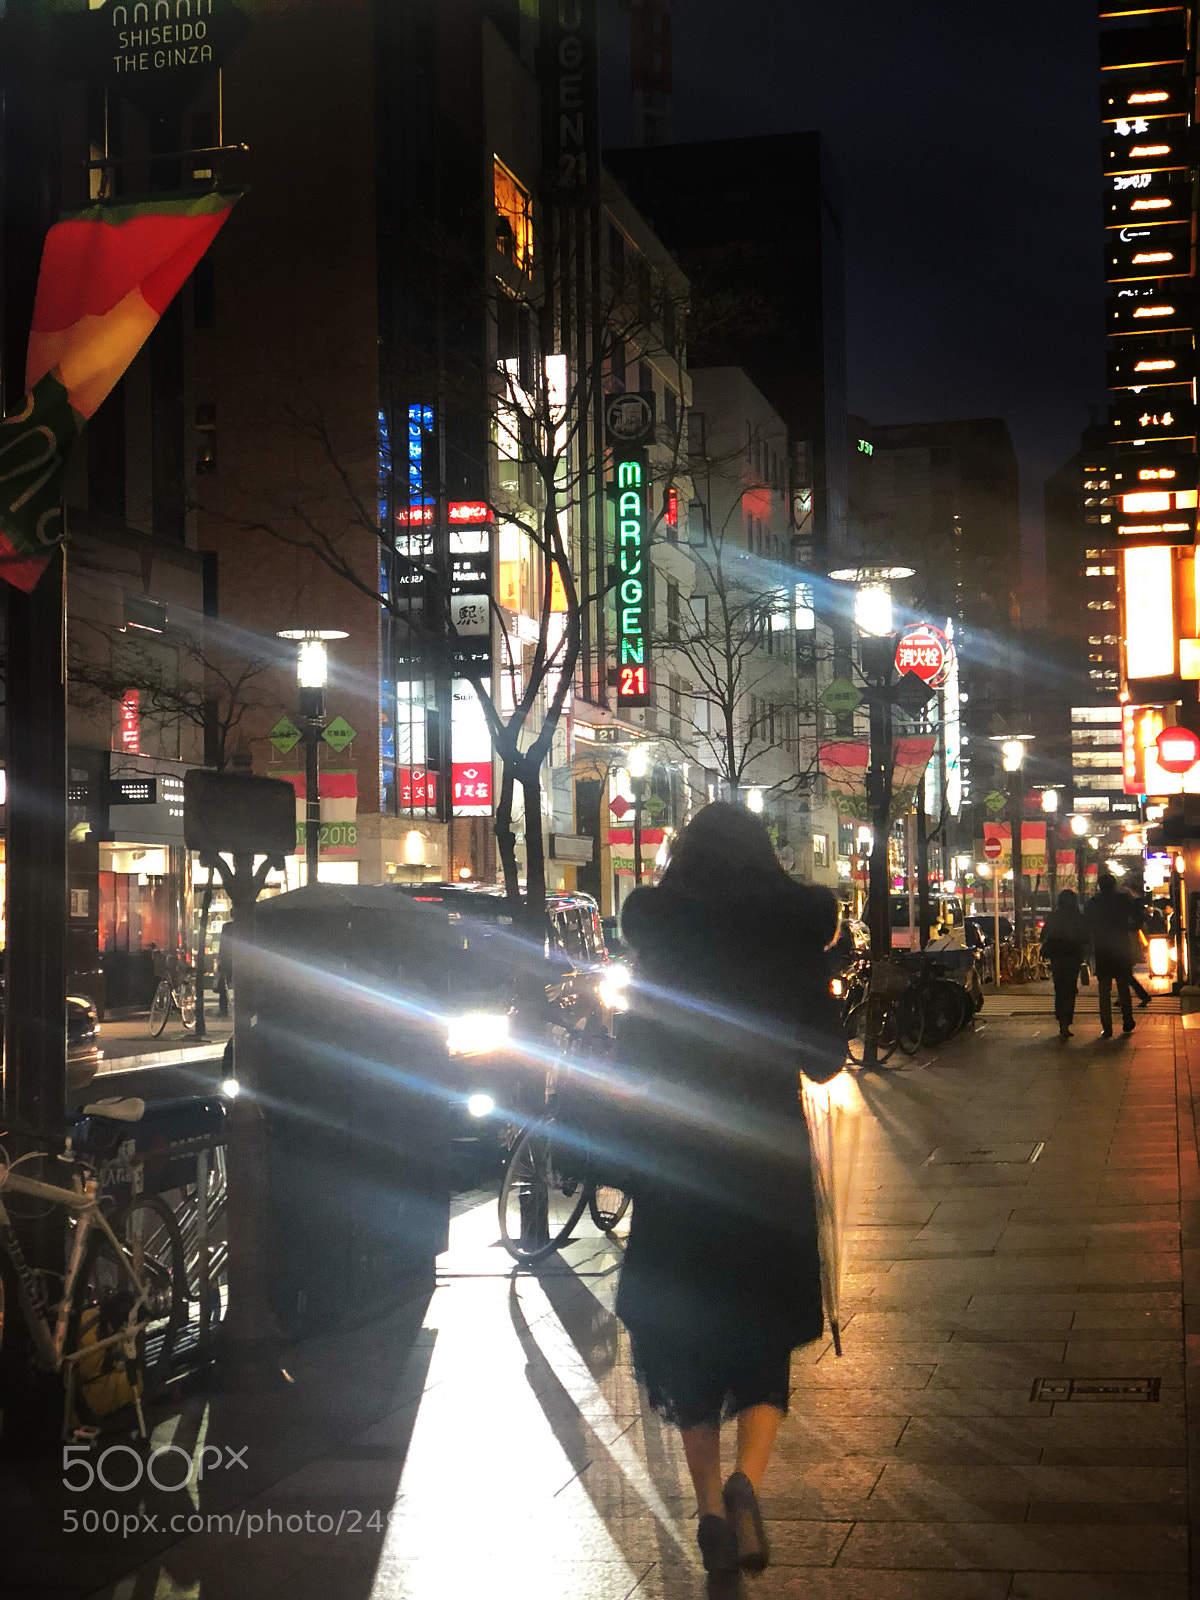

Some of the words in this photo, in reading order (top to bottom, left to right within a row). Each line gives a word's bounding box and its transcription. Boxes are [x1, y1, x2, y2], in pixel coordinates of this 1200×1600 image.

[118, 20, 207, 49] SHISEIDO
[113, 52, 149, 73] THE
[154, 44, 212, 69] GINZA
[617, 460, 644, 666] MARUGEN
[899, 648, 940, 667] 消火栓
[620, 667, 646, 696] 21
[599, 730, 615, 741] 21
[320, 826, 358, 845] 2018
